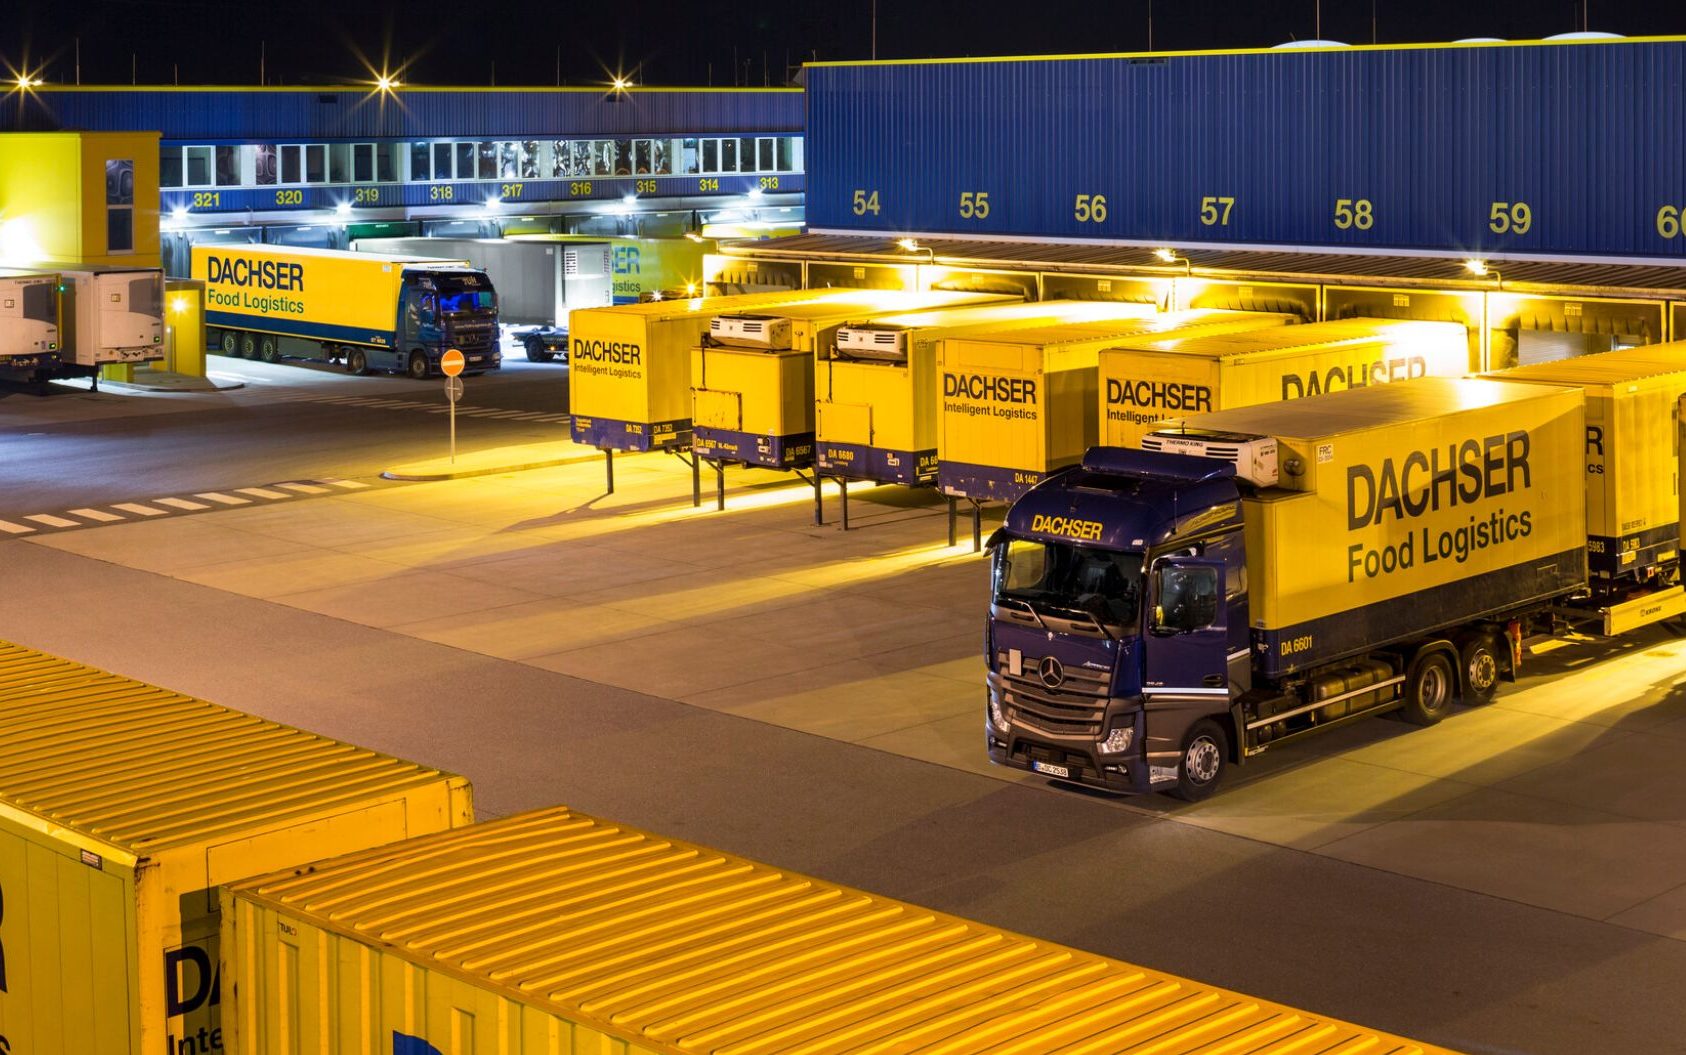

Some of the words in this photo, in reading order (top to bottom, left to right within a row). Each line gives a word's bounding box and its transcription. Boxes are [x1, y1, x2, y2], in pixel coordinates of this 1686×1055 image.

[430, 185, 454, 200] 318
[502, 183, 523, 198] 317
[571, 182, 592, 196] 316
[636, 179, 657, 194] 315
[699, 178, 719, 192] 314
[759, 176, 779, 190] 313
[193, 193, 220, 208] 321
[276, 190, 303, 205] 320
[355, 188, 379, 203] 319
[853, 190, 880, 216] 54
[959, 192, 990, 219] 55
[1074, 194, 1107, 223] 56
[1201, 197, 1235, 226] 57
[1334, 199, 1374, 231] 58
[1489, 202, 1532, 235] 59
[612, 246, 640, 275] ER
[208, 256, 304, 292] DACHSER
[208, 289, 240, 307] Food
[244, 292, 304, 314] Logistics
[574, 339, 641, 366] DACHSER
[574, 363, 608, 378] Intelligent
[609, 366, 642, 379] Logistics
[944, 373, 1037, 405] DACHSER
[1106, 378, 1212, 412] DACHSER
[944, 402, 991, 418] Intelligent
[993, 405, 1037, 420] Logistics
[1107, 409, 1158, 425] Intelligent
[1166, 439, 1189, 447] THERMO
[828, 449, 838, 458] DA
[920, 456, 928, 467] DA
[1015, 472, 1024, 482] DA
[1347, 430, 1531, 531] DACHSER
[1031, 515, 1104, 540] DACHSER
[1348, 541, 1414, 582] Food
[1424, 509, 1532, 563] Logistics
[1281, 641, 1293, 656] DA
[1293, 635, 1313, 654] 6601
